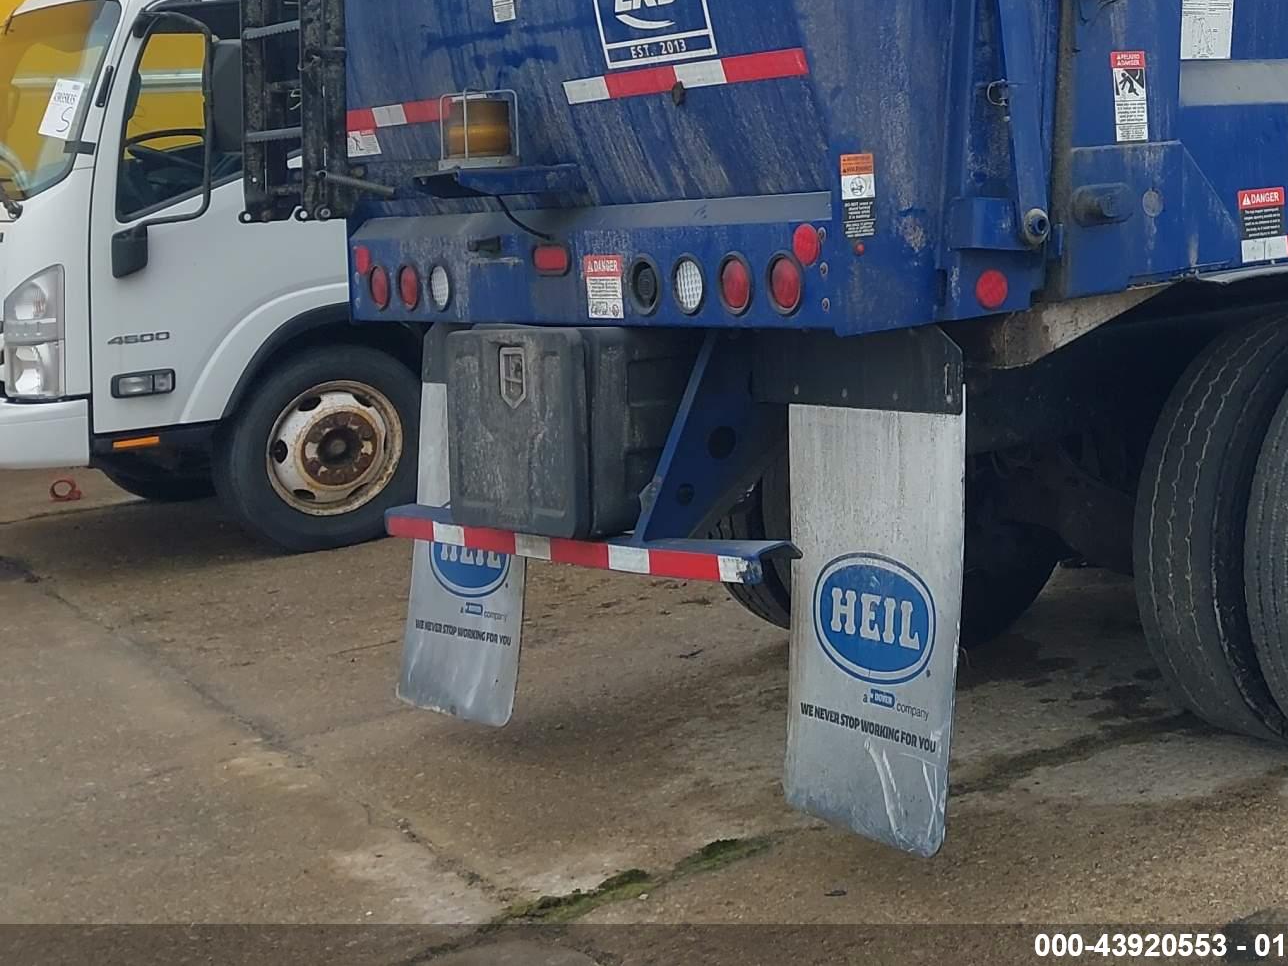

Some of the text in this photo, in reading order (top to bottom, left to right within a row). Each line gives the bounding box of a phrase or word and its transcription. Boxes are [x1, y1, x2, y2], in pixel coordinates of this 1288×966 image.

[630, 39, 687, 59] EST. 2013
[1251, 191, 1280, 204] DANGER
[594, 259, 619, 272] DANGER
[107, 331, 170, 345] 4500
[831, 587, 920, 651] HEIL
[415, 618, 512, 646] WE NEVER STOP WORKING FOR YOU
[862, 694, 868, 703] a
[896, 703, 930, 722] company
[800, 702, 937, 753] WE NEVER STOP WORKING FOR YOU
